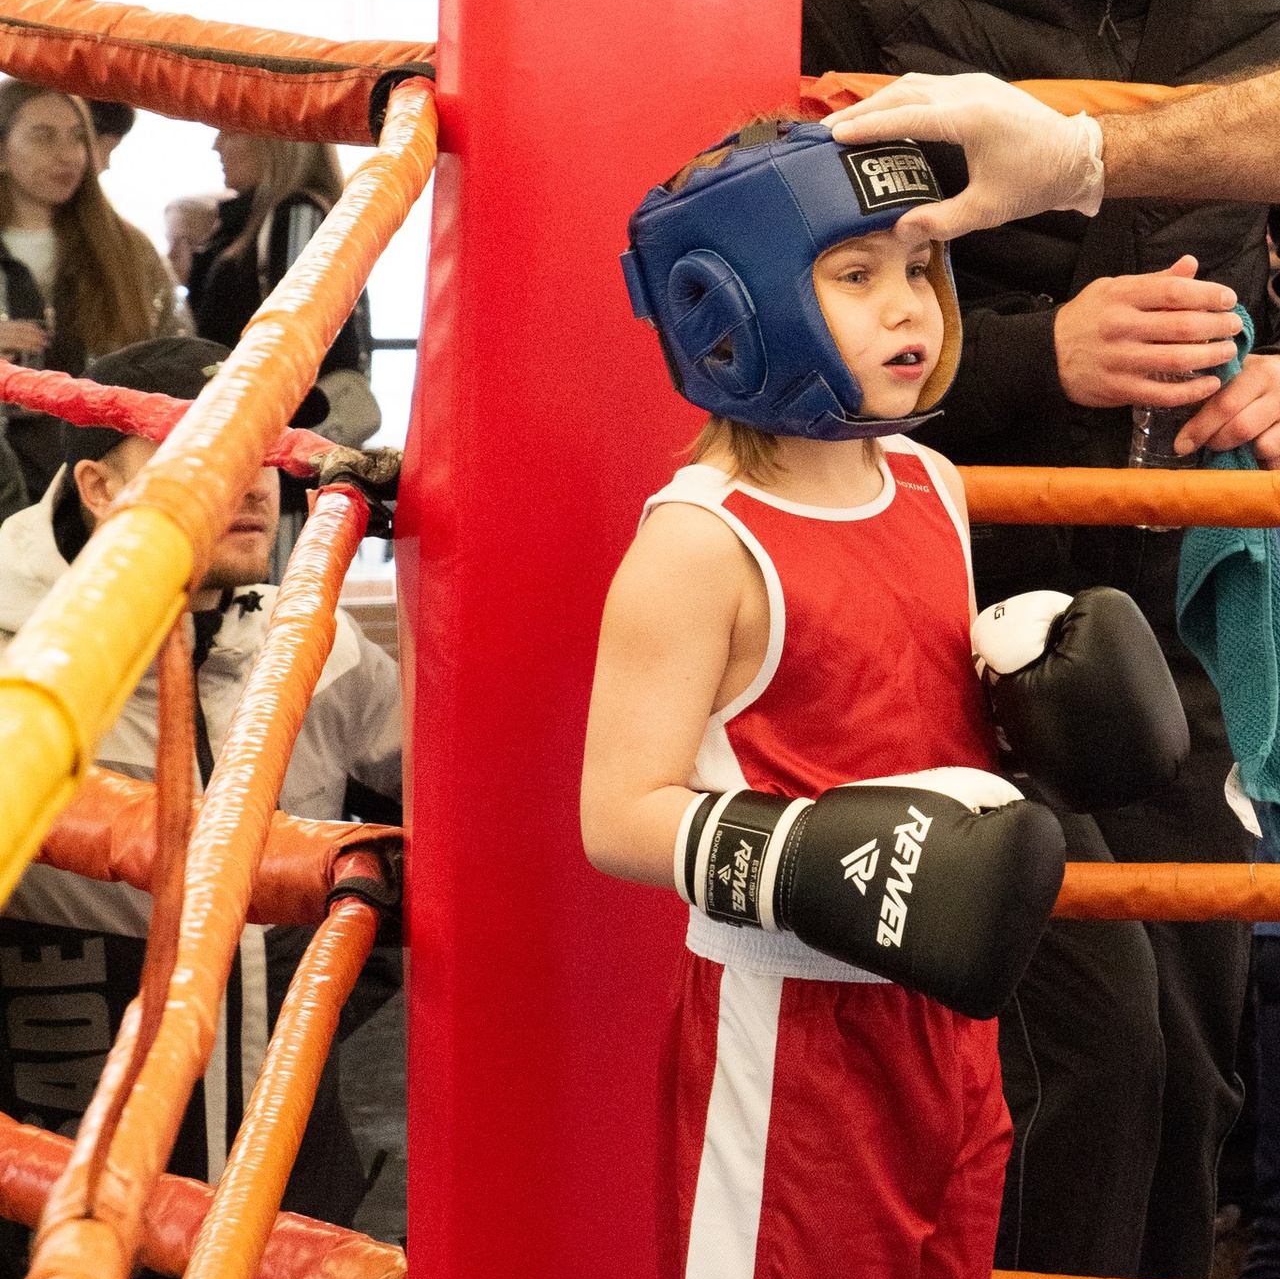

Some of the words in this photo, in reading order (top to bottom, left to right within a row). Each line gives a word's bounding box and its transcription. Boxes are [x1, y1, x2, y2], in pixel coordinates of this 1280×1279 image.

[861, 154, 928, 176] GREEN
[869, 170, 930, 197] HILL
[711, 829, 723, 863] BOXING
